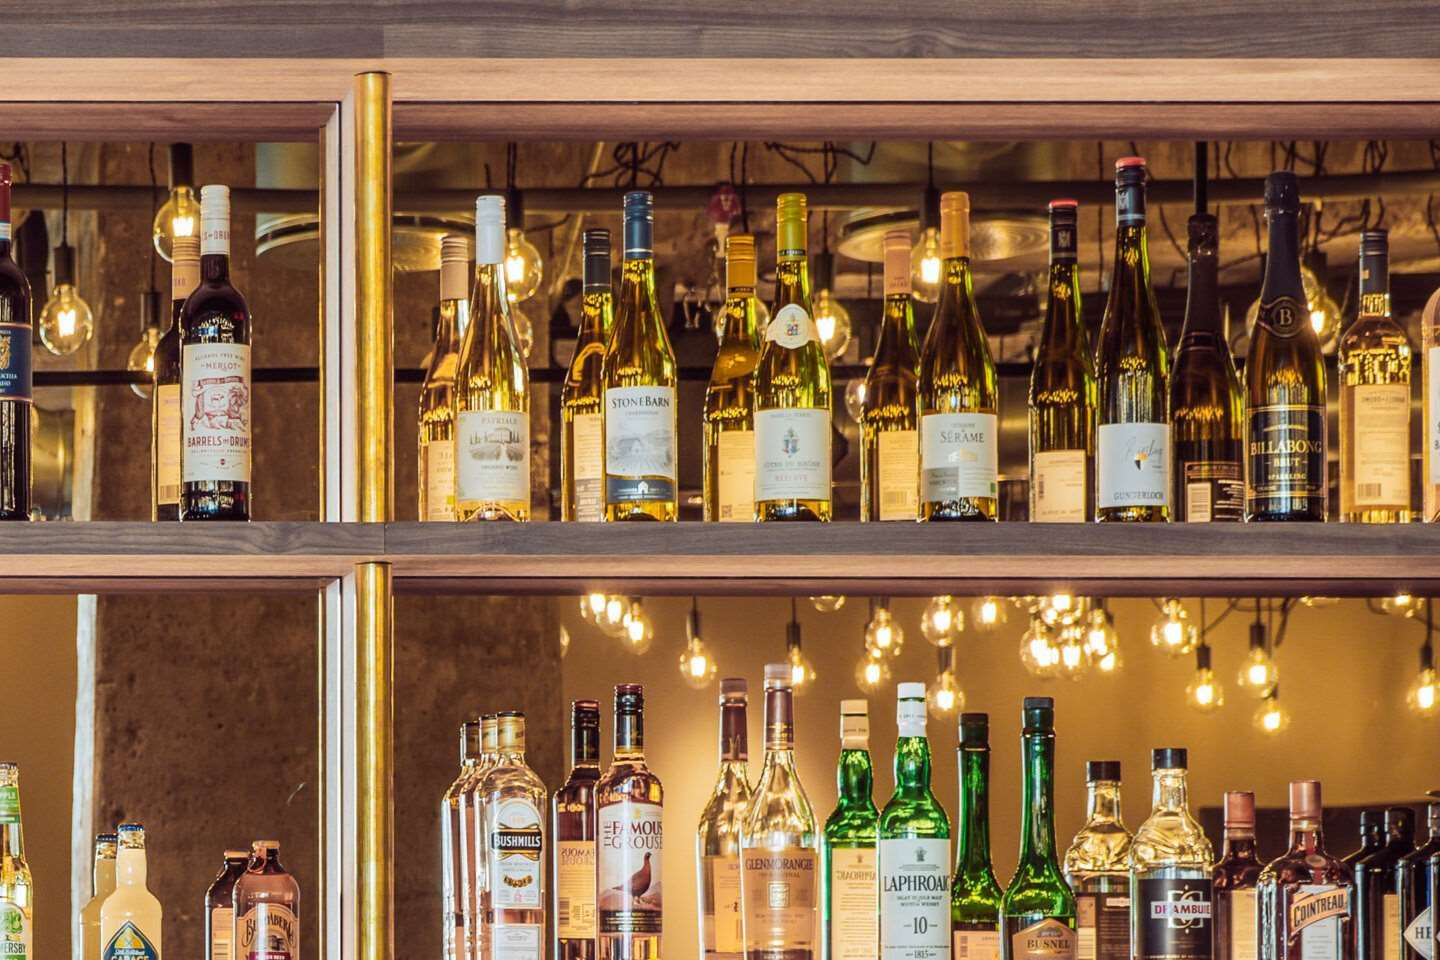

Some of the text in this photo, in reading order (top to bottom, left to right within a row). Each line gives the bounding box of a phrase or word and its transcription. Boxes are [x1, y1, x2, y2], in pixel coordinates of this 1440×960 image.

[1279, 308, 1293, 326] B
[187, 437, 223, 448] BARRELS
[1250, 439, 1323, 456] BILLABONG
[1272, 457, 1301, 468] BRUT
[612, 821, 663, 836] FAMOUS
[495, 835, 542, 848] BUSHMILLS
[745, 858, 814, 870] GLENMORANGIE
[1293, 893, 1345, 929] COINTREAU
[913, 915, 929, 935] 10
[1026, 939, 1071, 949] BUSNEL
